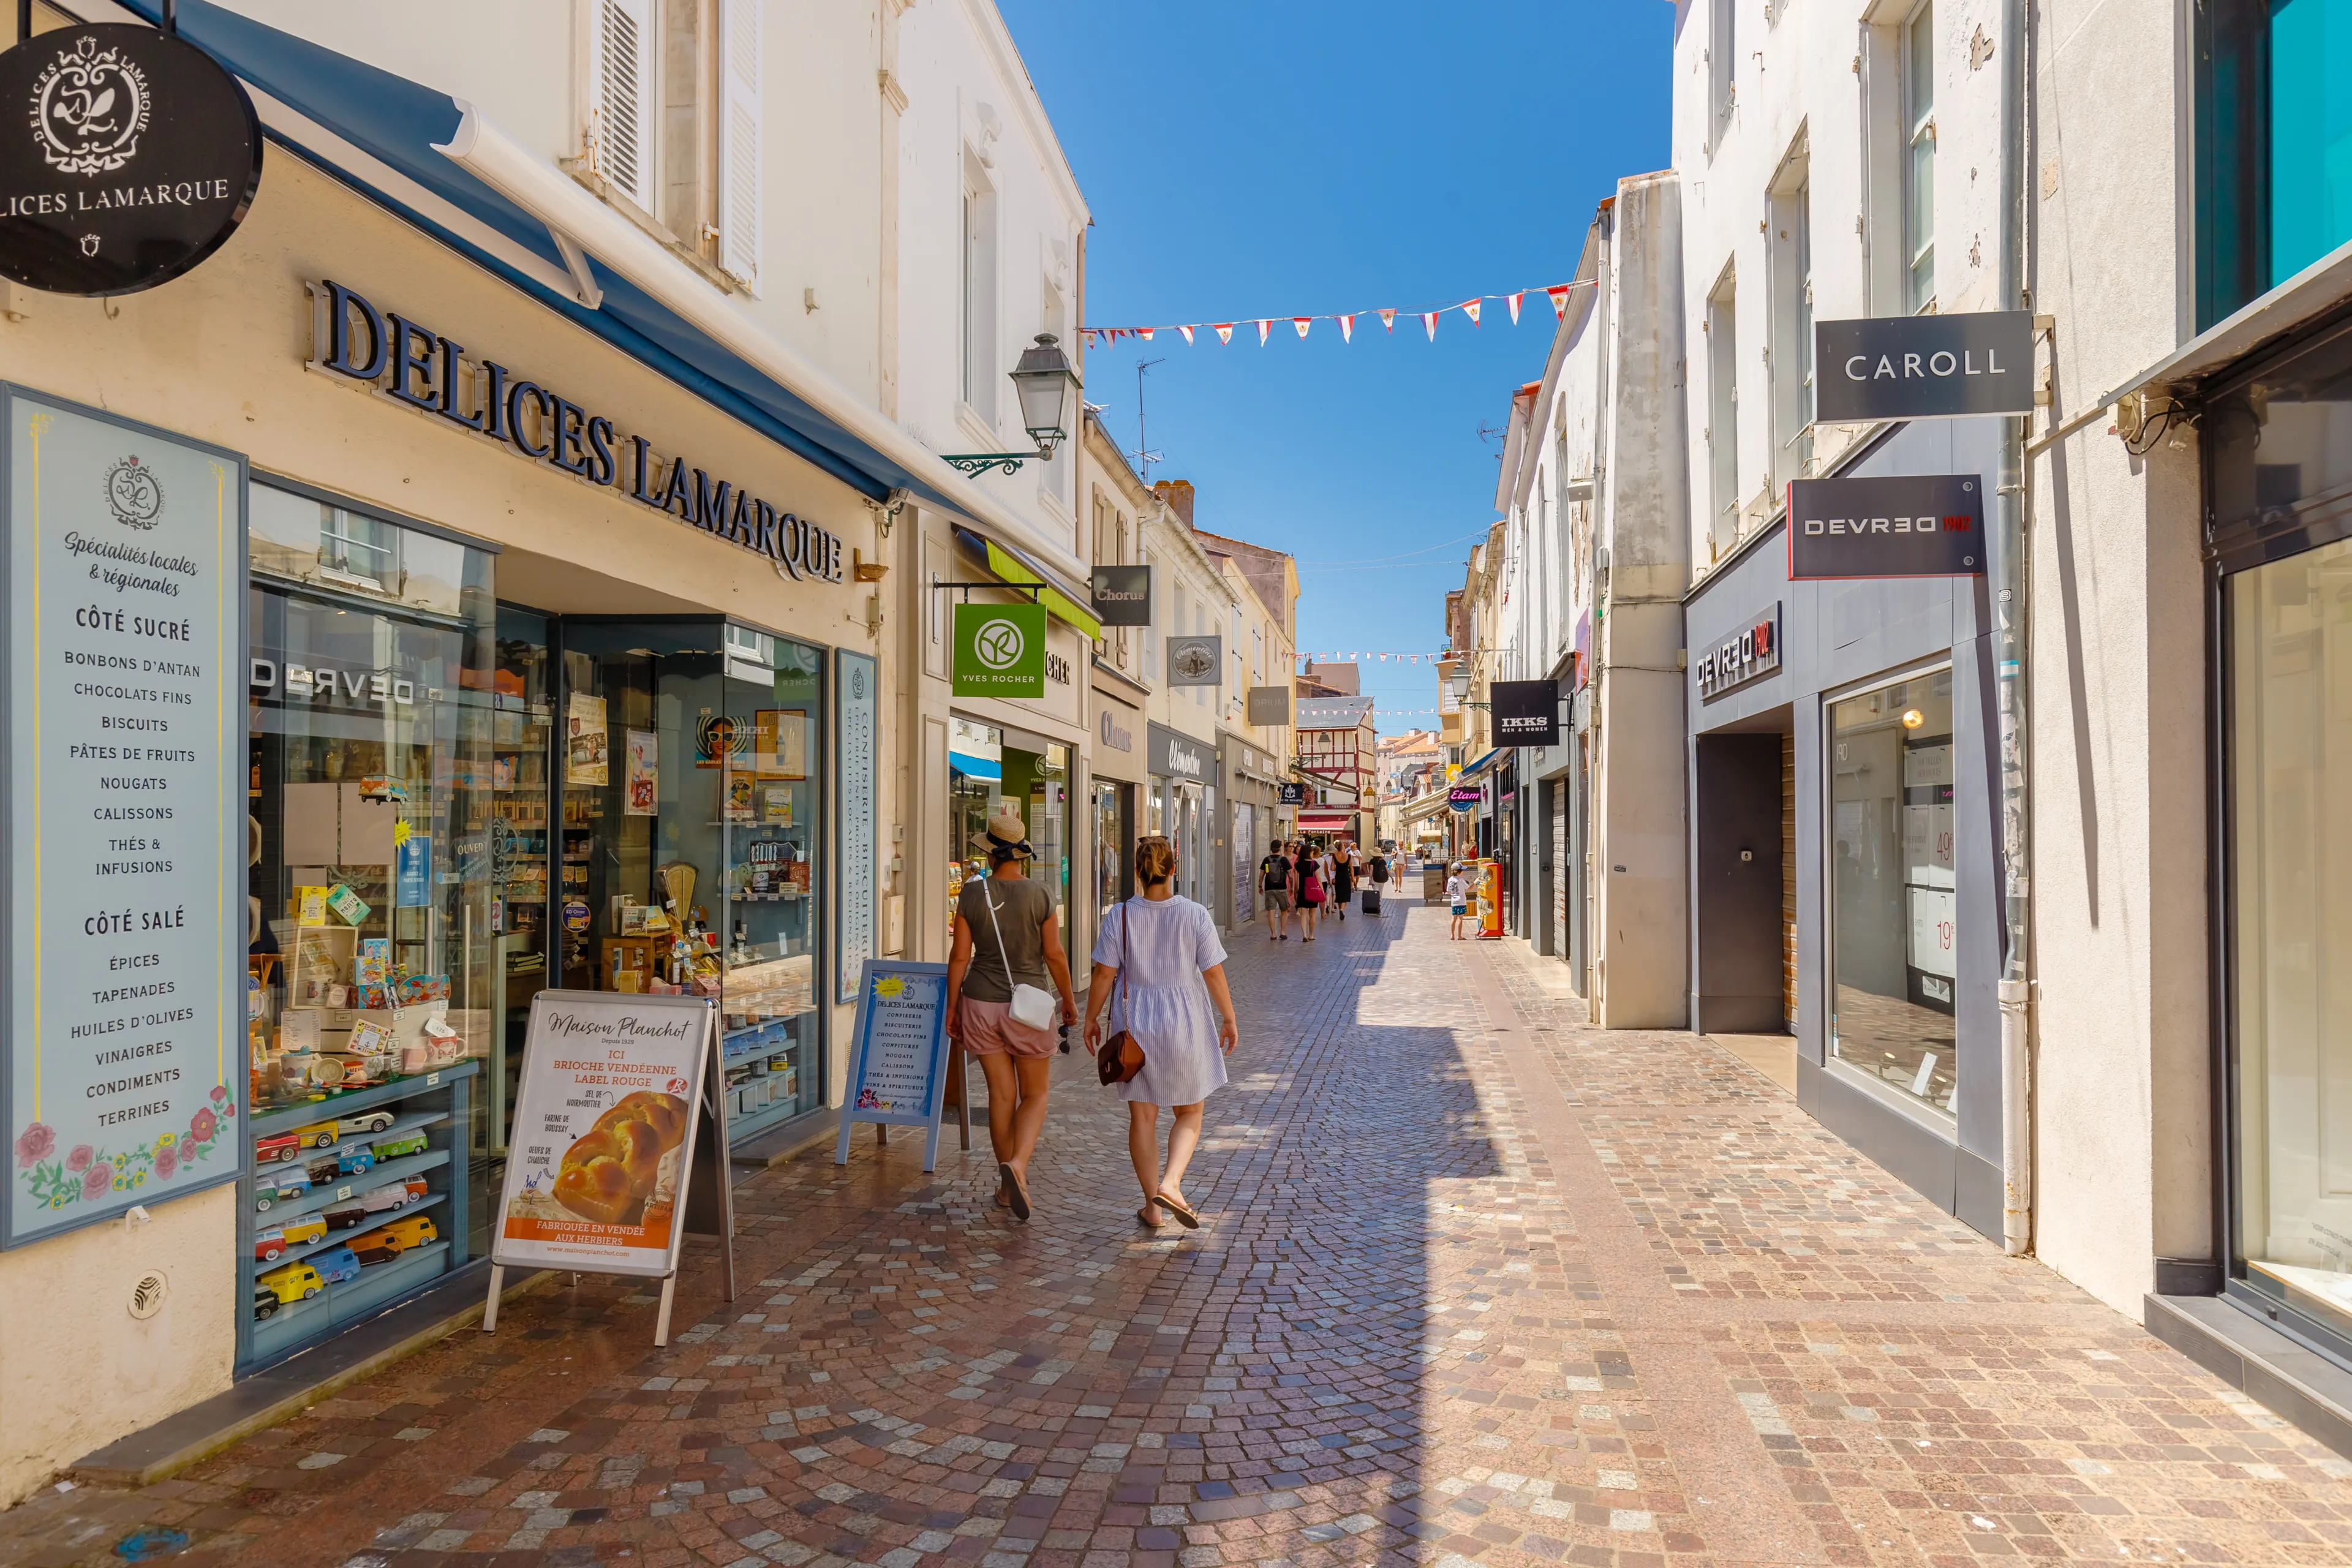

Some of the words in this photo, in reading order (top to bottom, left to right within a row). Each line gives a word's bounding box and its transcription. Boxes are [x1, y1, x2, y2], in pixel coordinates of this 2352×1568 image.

[29, 62, 57, 142] DELICES
[119, 56, 152, 132] LAMARQUE
[78, 179, 229, 211] LAMARQUE
[1845, 349, 2005, 381] CAROLL
[322, 279, 614, 486] DELICES
[630, 434, 843, 584] LAMARQUE
[1804, 516, 1936, 535] DEVRED
[1942, 515, 1972, 532] 1902
[64, 531, 148, 564] Spécialités
[149, 551, 199, 576] locales
[89, 564, 100, 579] &
[103, 568, 180, 597] régionales
[1096, 588, 1145, 601] Chorus
[76, 604, 124, 632] CÔTÉ
[134, 617, 190, 641] SUCRÉ
[1755, 619, 1769, 658] 1902
[64, 651, 137, 670] BONBONS
[143, 660, 200, 677] D'ANTAN
[74, 683, 157, 701] CHOCOLATS
[162, 692, 192, 705] FINS
[1253, 698, 1286, 707] OPIUM
[102, 717, 168, 731] BISCUITS
[1502, 717, 1547, 727] IKKS
[1102, 710, 1132, 753] Chorus
[70, 742, 117, 759] PÂTES
[123, 748, 141, 760] DE
[146, 749, 195, 762] FRUITS
[1169, 739, 1200, 776] Clémentine
[100, 777, 167, 790] NOUGATS
[1450, 790, 1480, 799] Etam
[94, 808, 173, 820] CALISSONS
[108, 836, 146, 851] THÉS
[152, 839, 160, 850] &
[96, 861, 173, 875] INFUSIONS
[341, 897, 358, 913] MOJITO
[84, 908, 132, 936] CÔTÉ
[141, 905, 184, 930] SALÉ
[110, 954, 160, 970] ÉPICES
[92, 982, 175, 1004] TAPENADES
[902, 1002, 935, 1011] LAMARQUE
[70, 1019, 125, 1039] HUILES
[130, 1008, 194, 1030] D'OLIVES
[549, 1012, 616, 1037] Maison
[618, 1017, 693, 1041] Planchot
[95, 1041, 172, 1066] VINAIGRES
[608, 1050, 625, 1059] ICI
[553, 1060, 604, 1071] BRIOCHE
[608, 1063, 677, 1075] VENDÉENNE
[86, 1068, 180, 1098] CONDIMENTS
[575, 1074, 609, 1085] LABEL
[612, 1076, 652, 1087] ROUGE
[567, 1099, 601, 1108] NOIRMOUTIER
[98, 1100, 170, 1127] TERRINES
[545, 1124, 568, 1133] BOUSSAY
[529, 1146, 545, 1155] OEUFS
[527, 1156, 551, 1164] CHAUCHE
[537, 1220, 589, 1232] FABRIQUÉE
[608, 1225, 645, 1236] VENDÉE
[577, 1235, 623, 1246] HERBIERS
[547, 1245, 630, 1257] www.maisonplanchot.com
